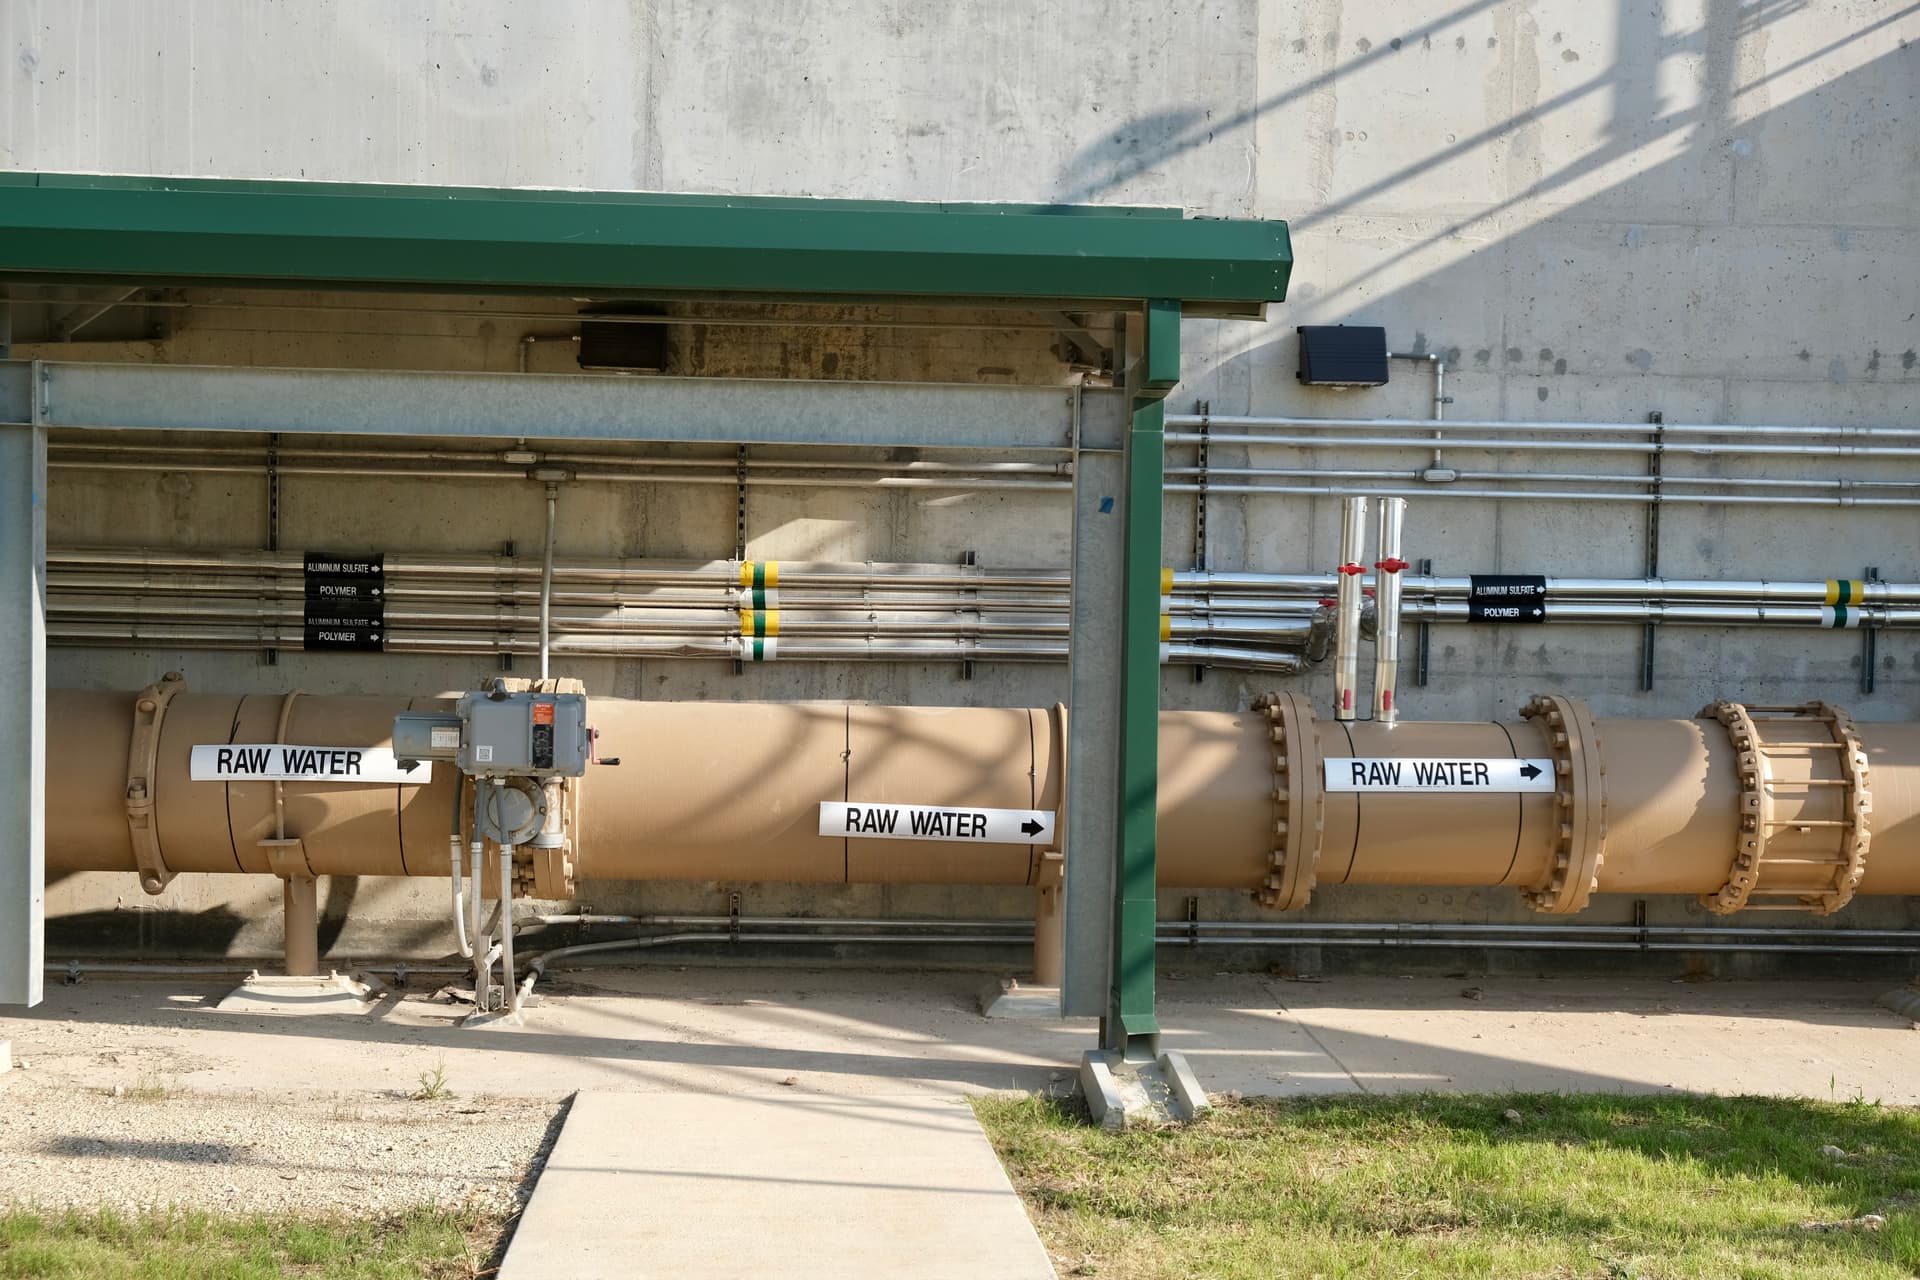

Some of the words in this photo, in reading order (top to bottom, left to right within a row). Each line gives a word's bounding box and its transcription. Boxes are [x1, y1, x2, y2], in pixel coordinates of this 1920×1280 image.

[308, 563, 341, 573] ALUMINUM
[342, 564, 369, 573] SULFATE
[320, 586, 357, 596] POLYMER
[1476, 586, 1508, 595] ALUMINUM
[1509, 585, 1535, 594] SULFATE
[1484, 608, 1519, 617] POLYMER
[342, 619, 369, 627] SULFATE
[319, 632, 356, 641] POLYMER
[217, 748, 271, 774] RAW
[282, 749, 362, 775] WATER
[1351, 761, 1401, 786] RAW
[1412, 761, 1490, 786] WATER
[845, 807, 899, 834] RAW
[910, 810, 988, 838] WATER
